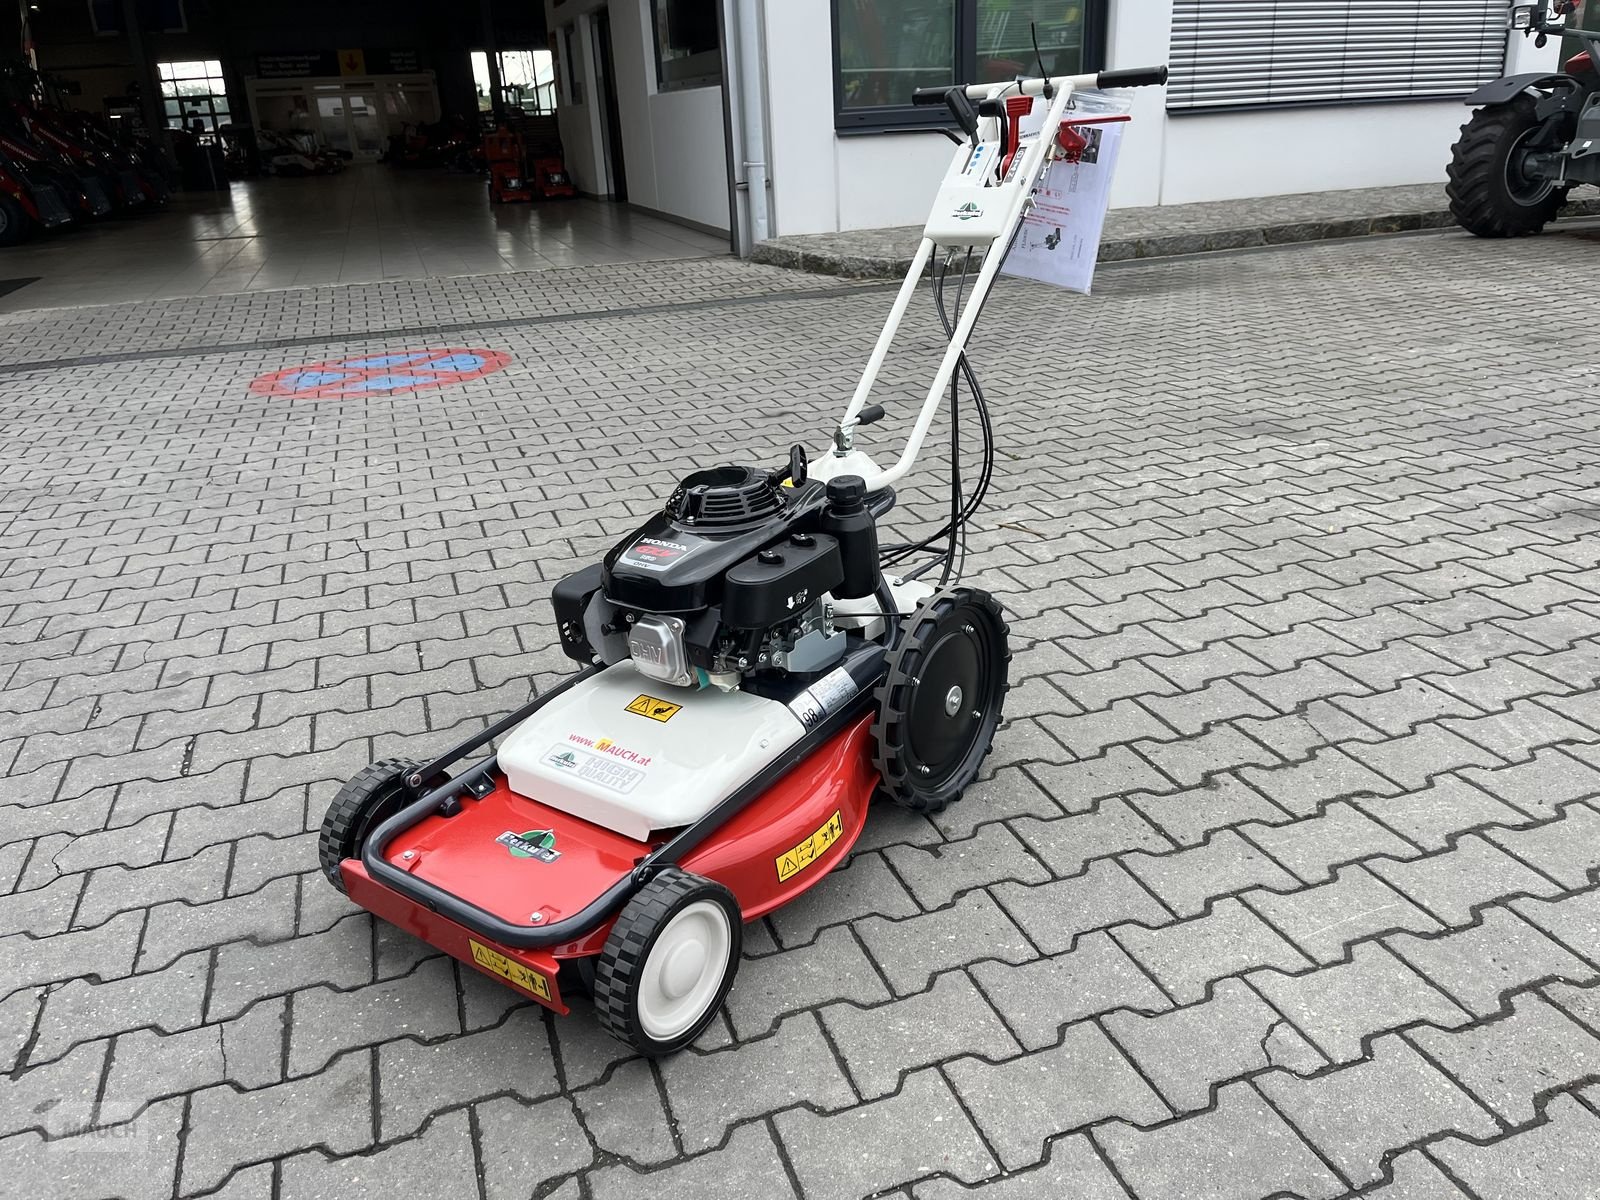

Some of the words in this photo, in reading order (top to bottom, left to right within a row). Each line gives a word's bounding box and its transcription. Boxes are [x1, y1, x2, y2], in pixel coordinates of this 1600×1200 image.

[641, 538, 687, 551] HONDA
[630, 640, 662, 665] OHV
[802, 707, 819, 727] 98
[578, 765, 632, 789] QUALITY
[584, 757, 638, 782] HIGH
